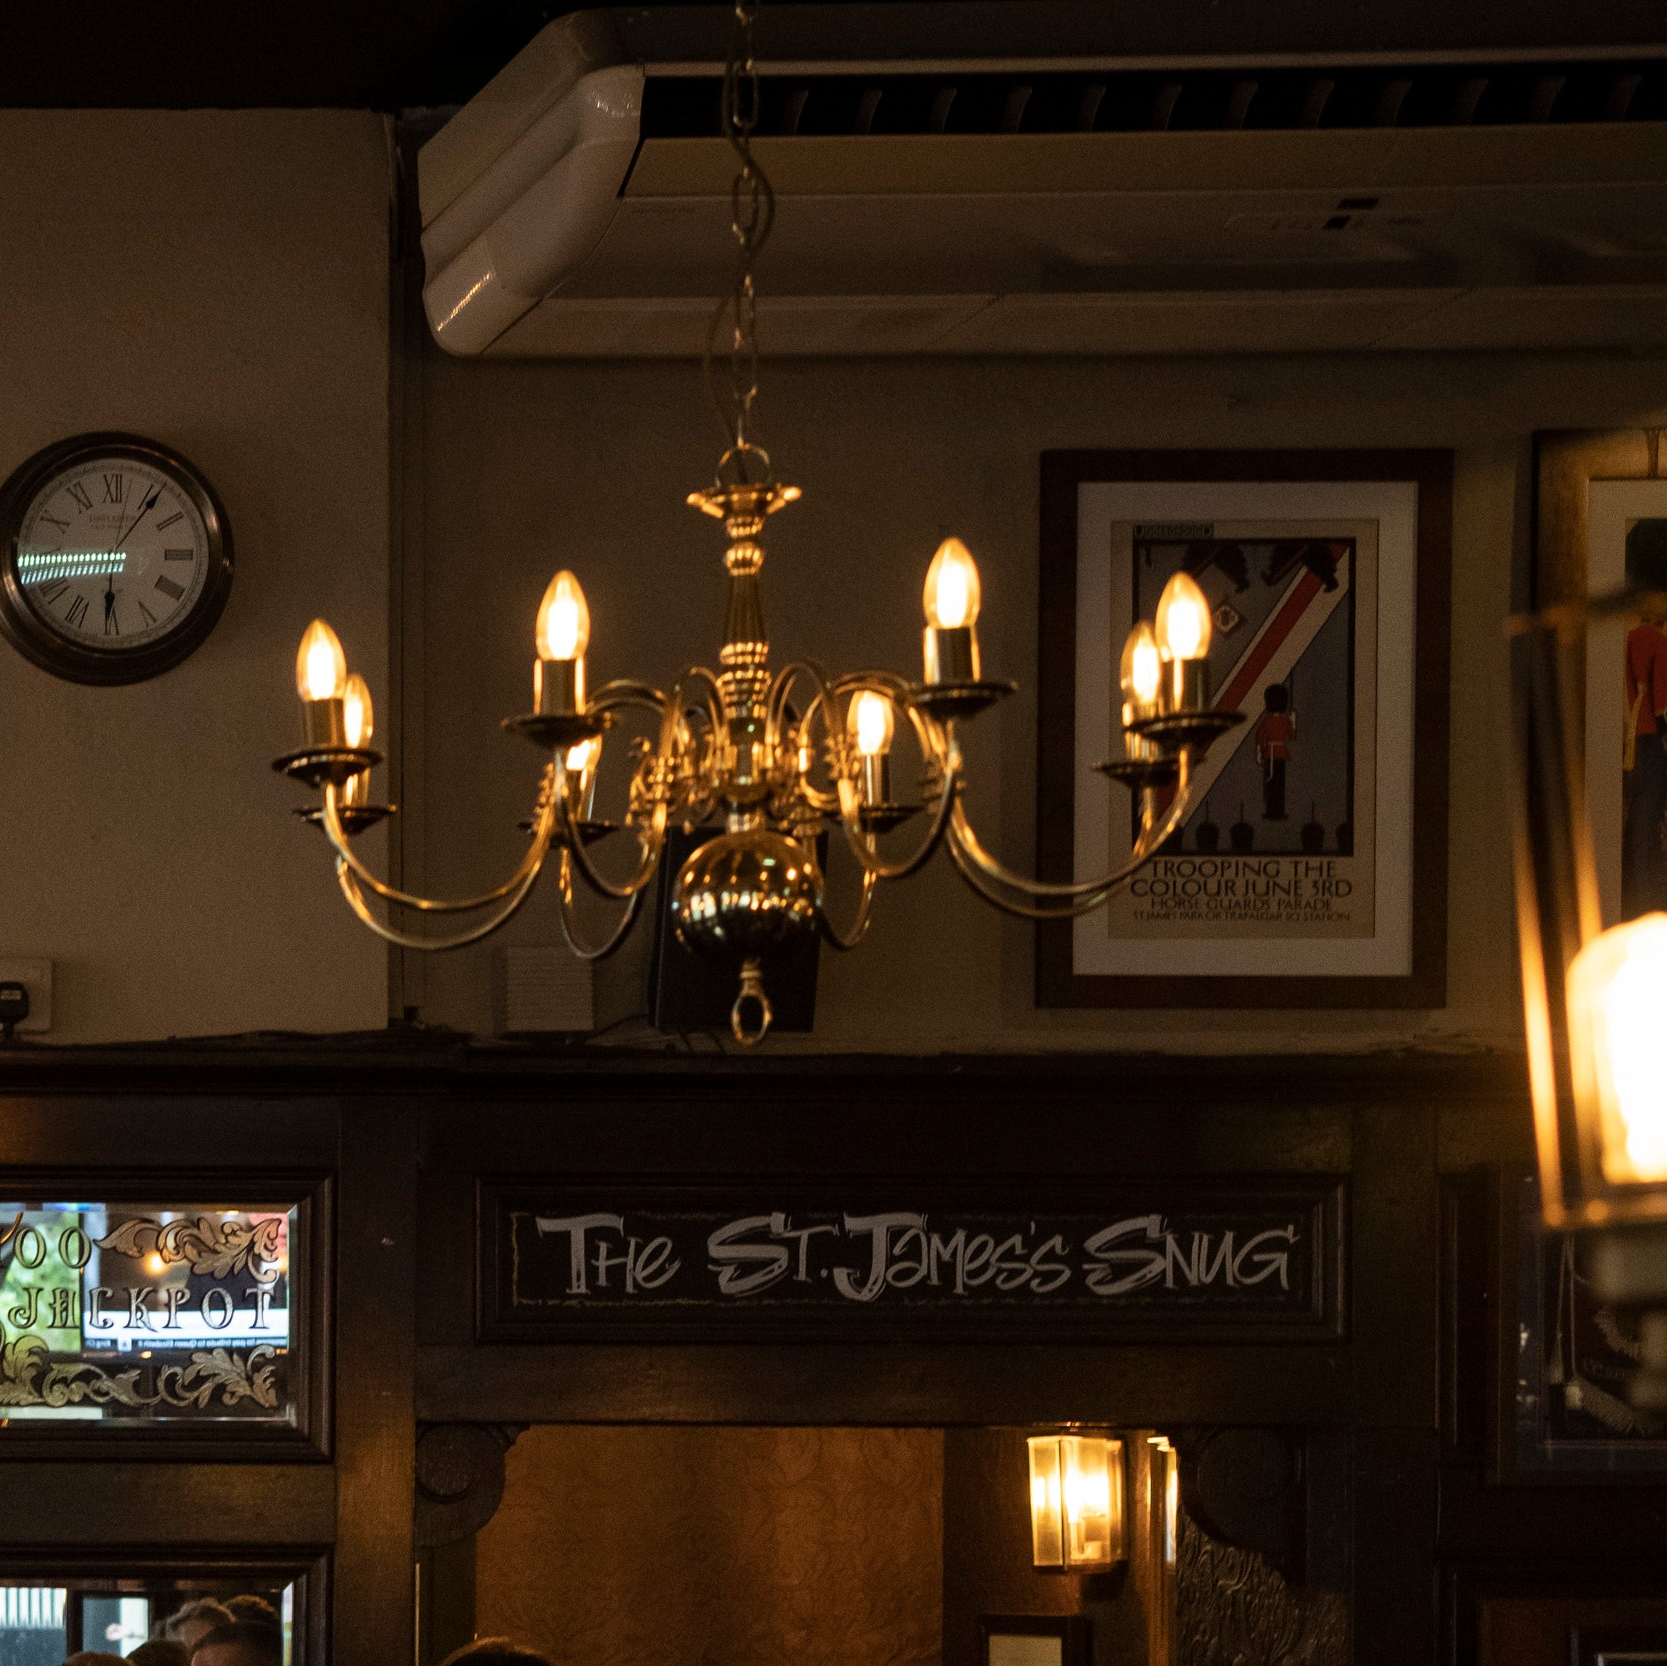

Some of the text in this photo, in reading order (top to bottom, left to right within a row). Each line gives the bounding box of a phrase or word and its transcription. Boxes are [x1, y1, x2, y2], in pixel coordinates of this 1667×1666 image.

[1152, 859, 1337, 879] TROOPING THE
[1130, 878, 1353, 898] COLOUR JUNE 3RD
[1277, 898, 1332, 911] PARADE
[7, 1286, 276, 1332] JACKPOT
